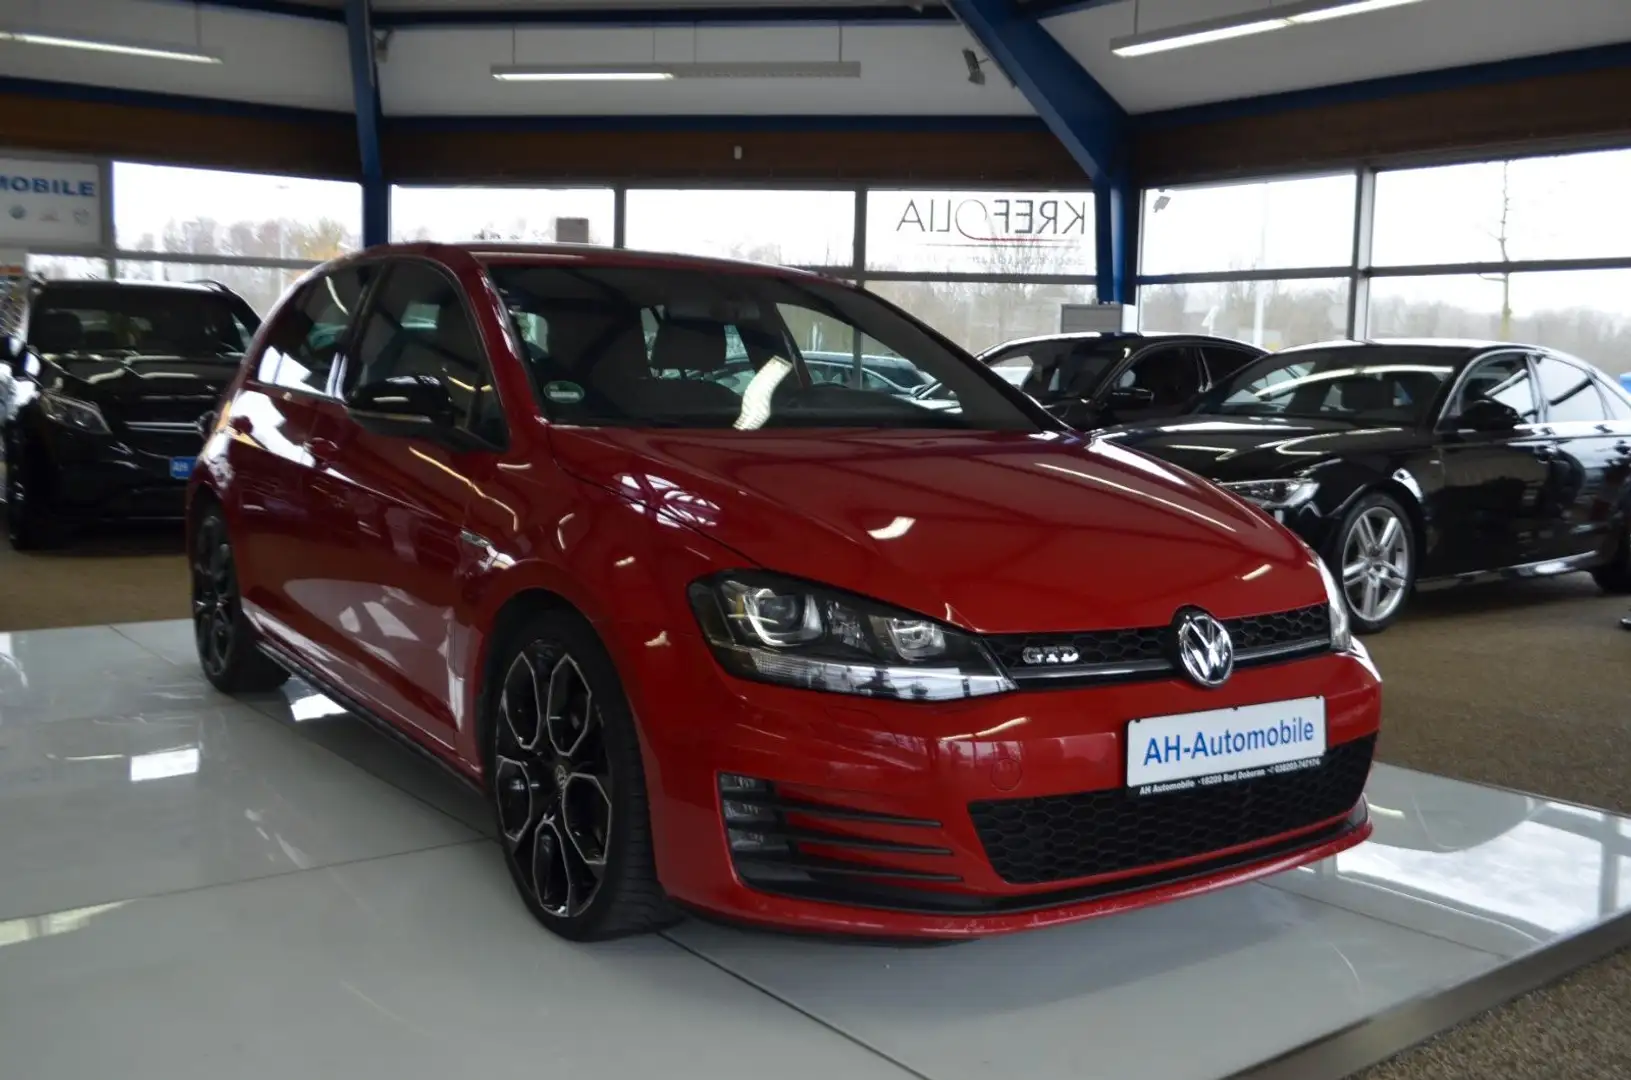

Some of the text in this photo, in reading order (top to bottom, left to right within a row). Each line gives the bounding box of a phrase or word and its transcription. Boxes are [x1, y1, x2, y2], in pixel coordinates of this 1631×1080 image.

[1023, 646, 1079, 664] GTD
[1143, 717, 1314, 766] AH-Automobile
[1152, 780, 1195, 793] Automobile
[1223, 772, 1237, 782] Bad
